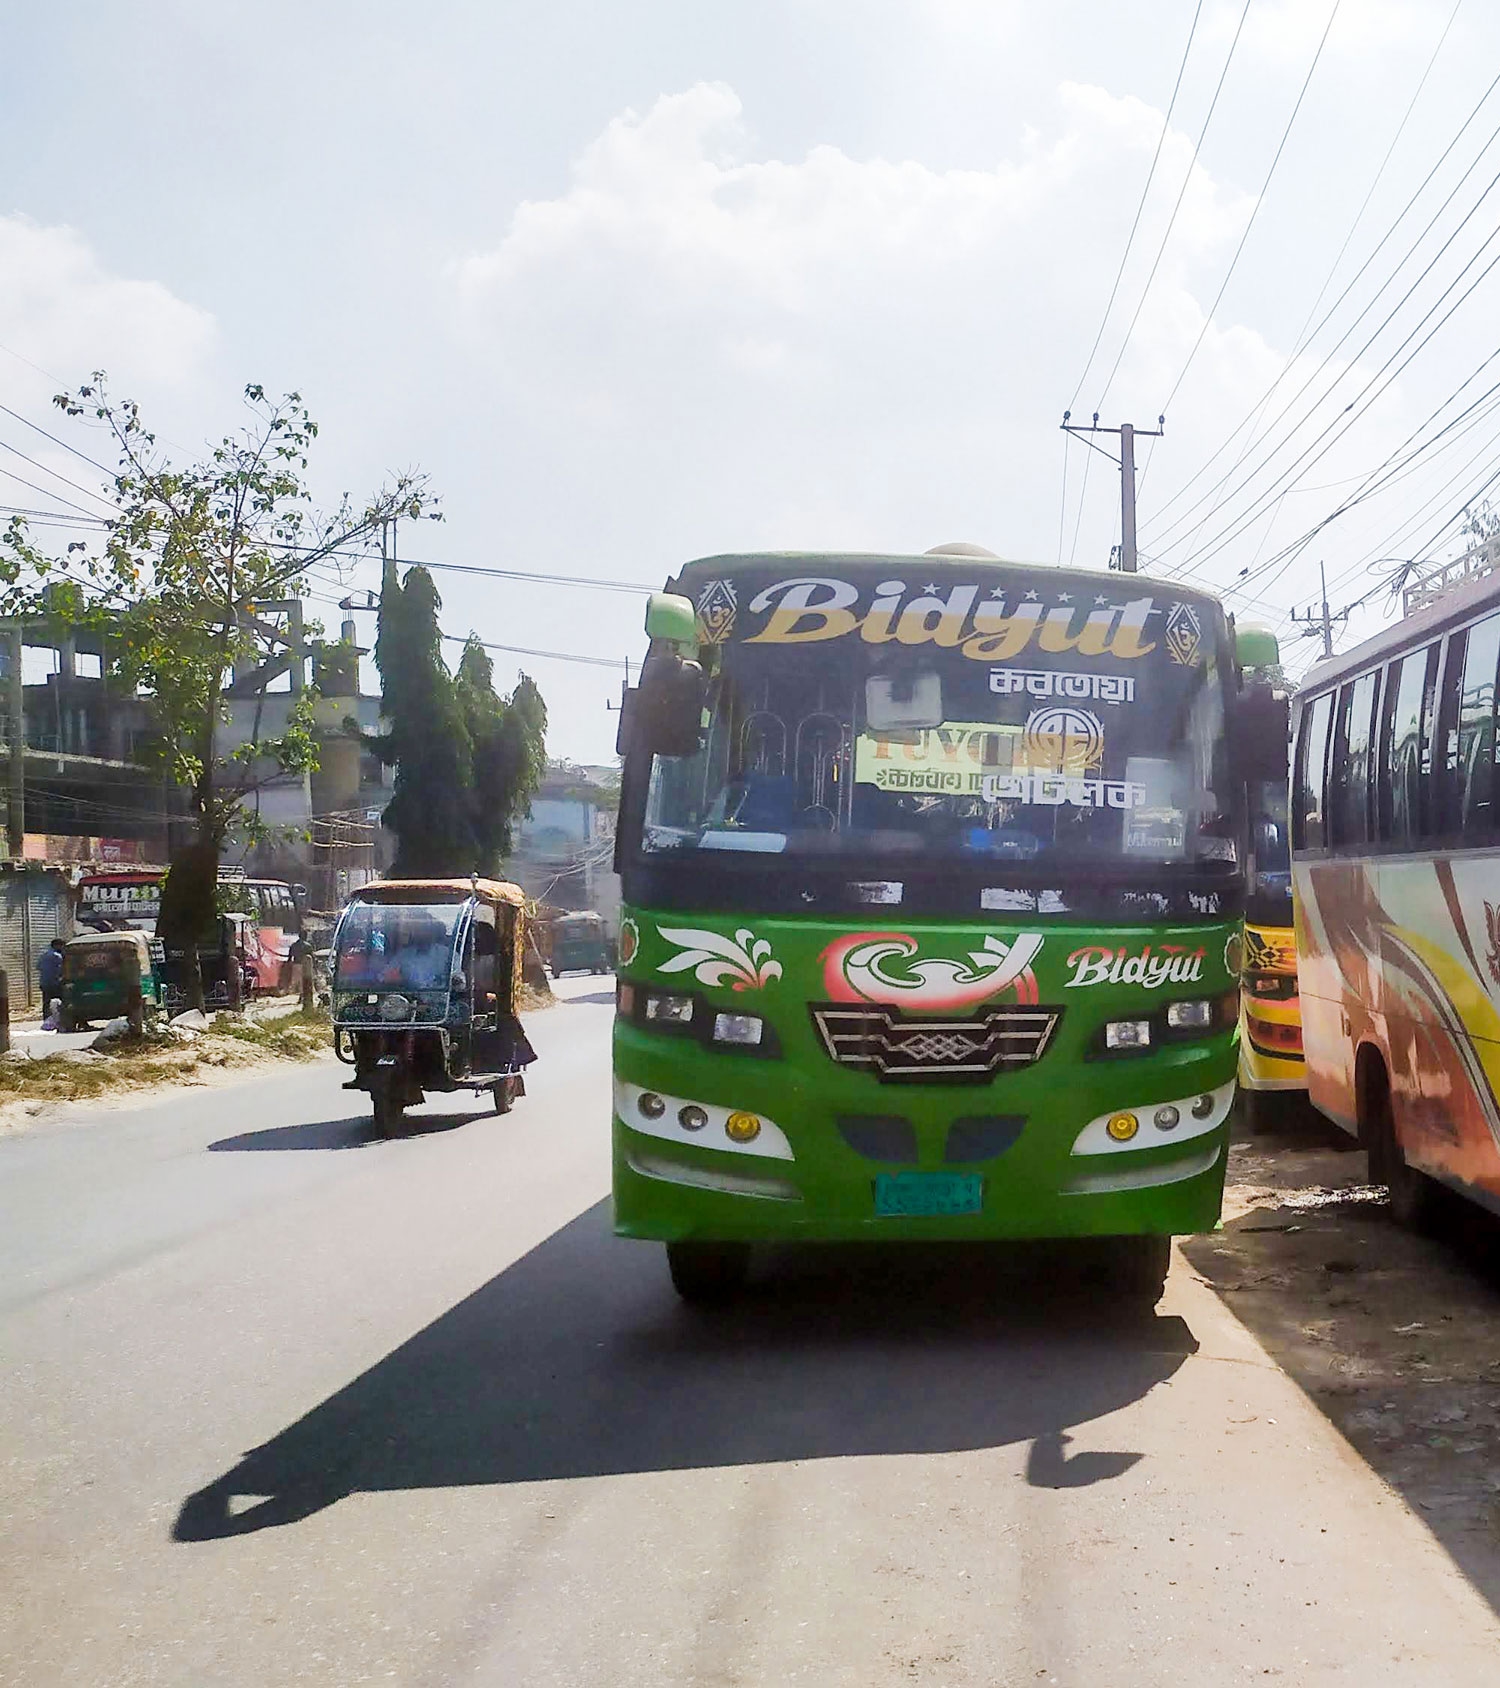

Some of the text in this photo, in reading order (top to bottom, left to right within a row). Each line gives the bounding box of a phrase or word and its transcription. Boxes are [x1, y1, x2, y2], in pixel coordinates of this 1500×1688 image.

[741, 576, 1163, 661] Bidyut
[989, 667, 1136, 705] করতোয়া
[1063, 944, 1205, 989] Bidyut
